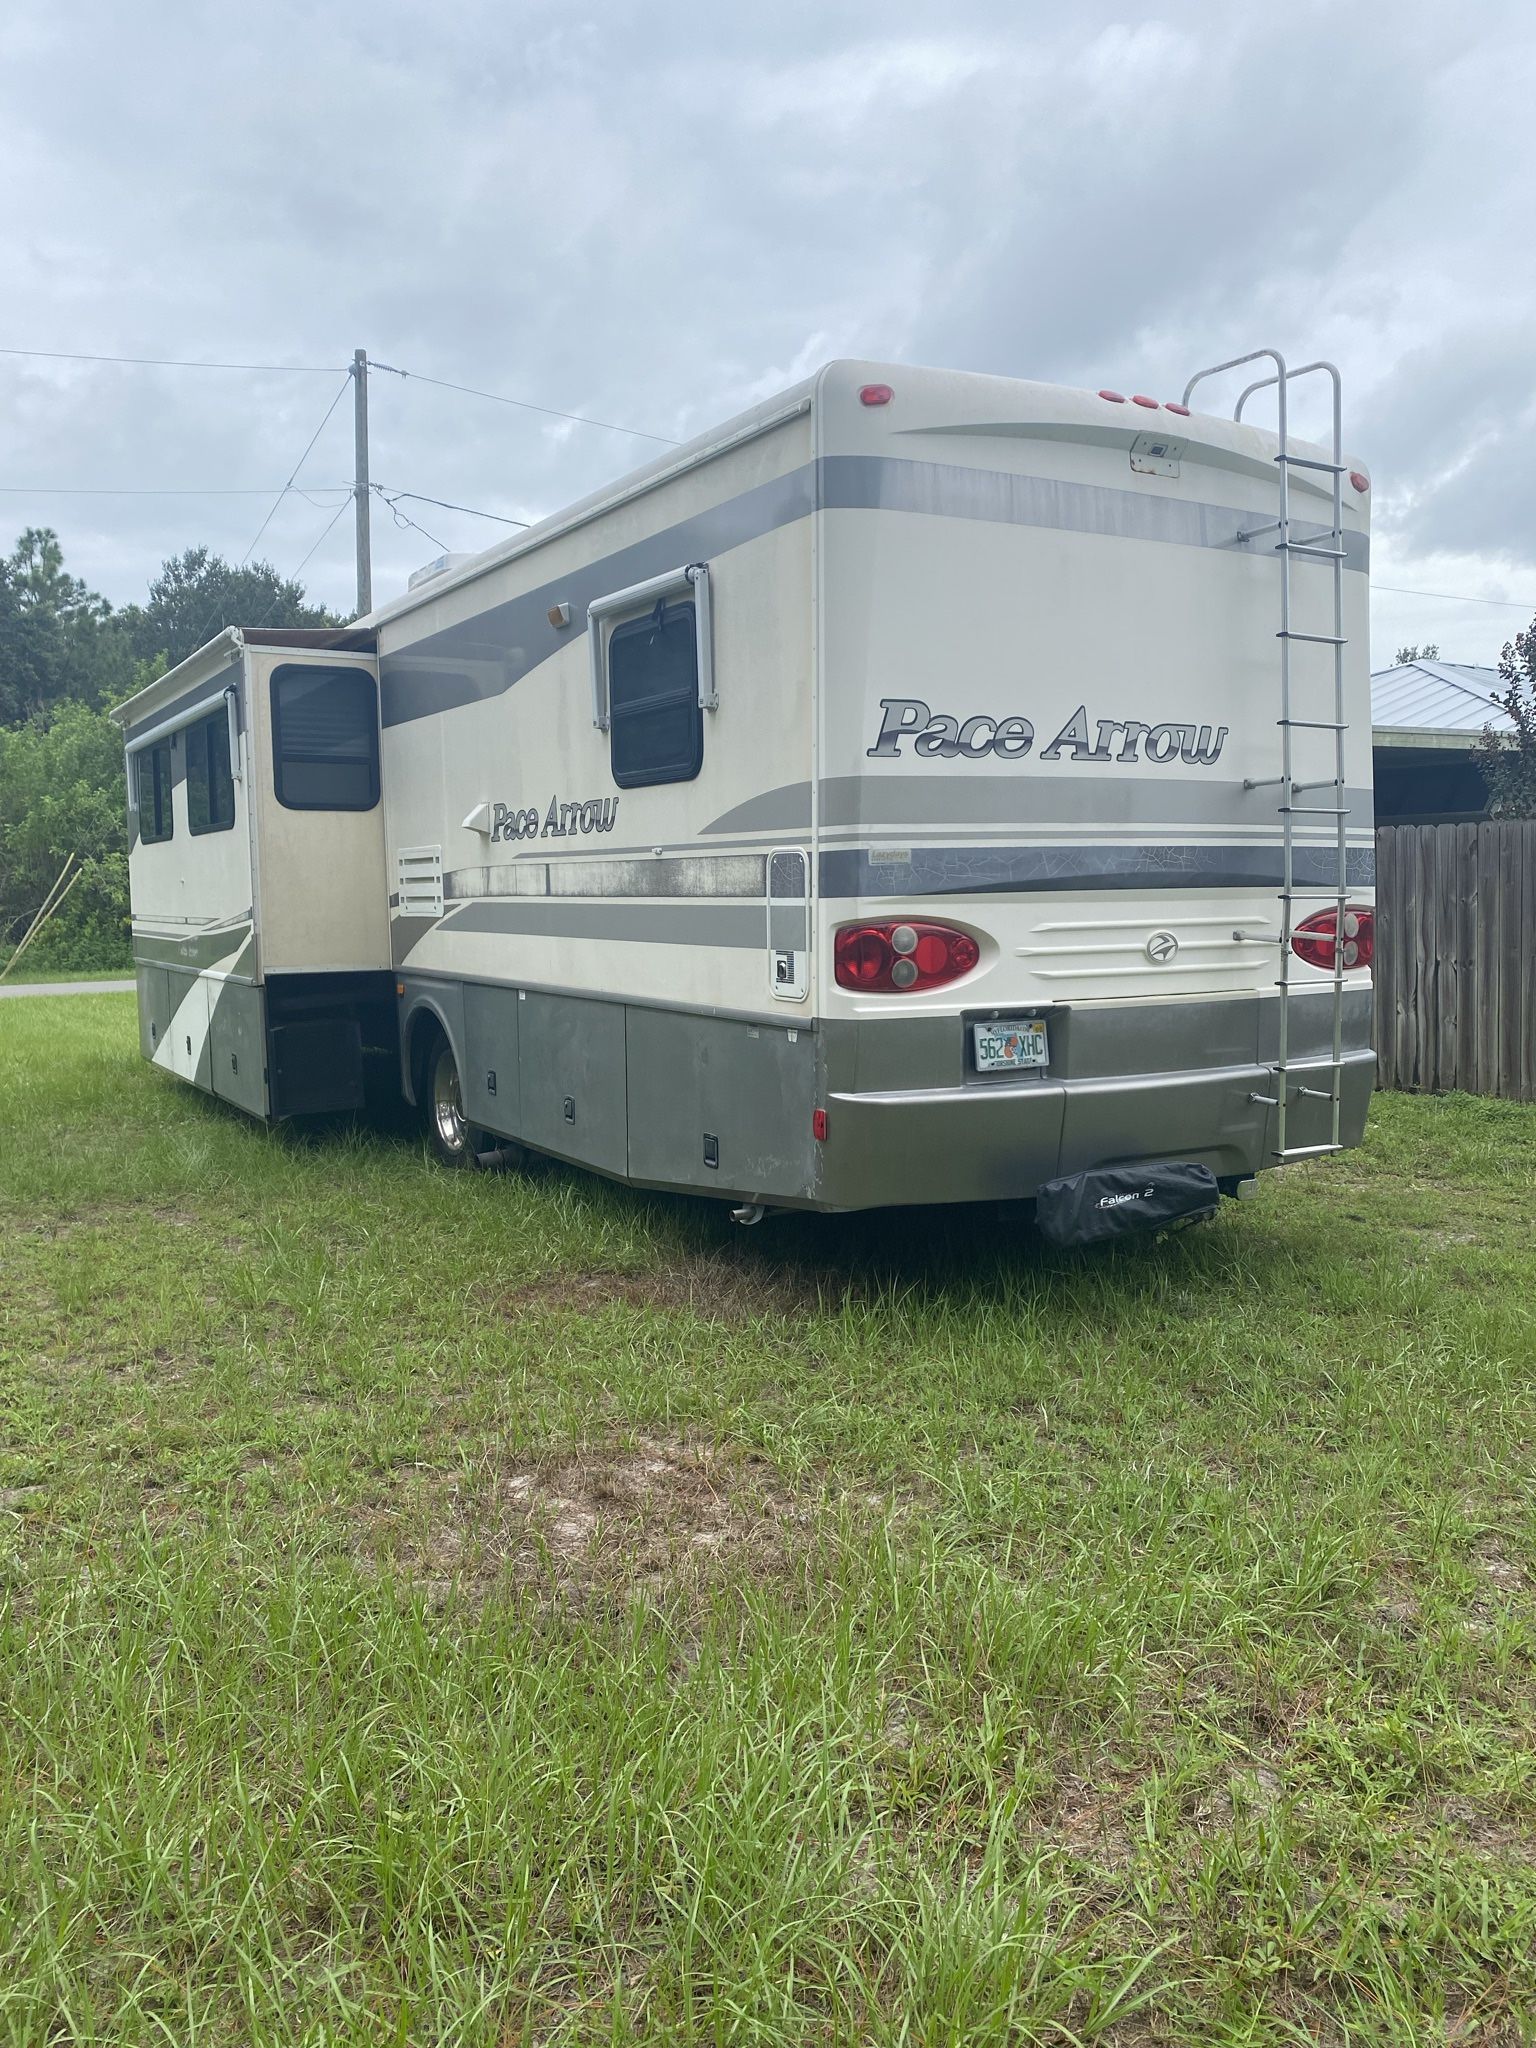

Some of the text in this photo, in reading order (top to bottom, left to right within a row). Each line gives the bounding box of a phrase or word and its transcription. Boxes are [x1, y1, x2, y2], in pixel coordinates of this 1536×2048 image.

[867, 699, 1229, 765] Pace Arrow
[491, 794, 620, 842] Pace Arrow
[980, 1034, 1043, 1060] 562 XHC
[1100, 1188, 1155, 1207] Falcon 2
